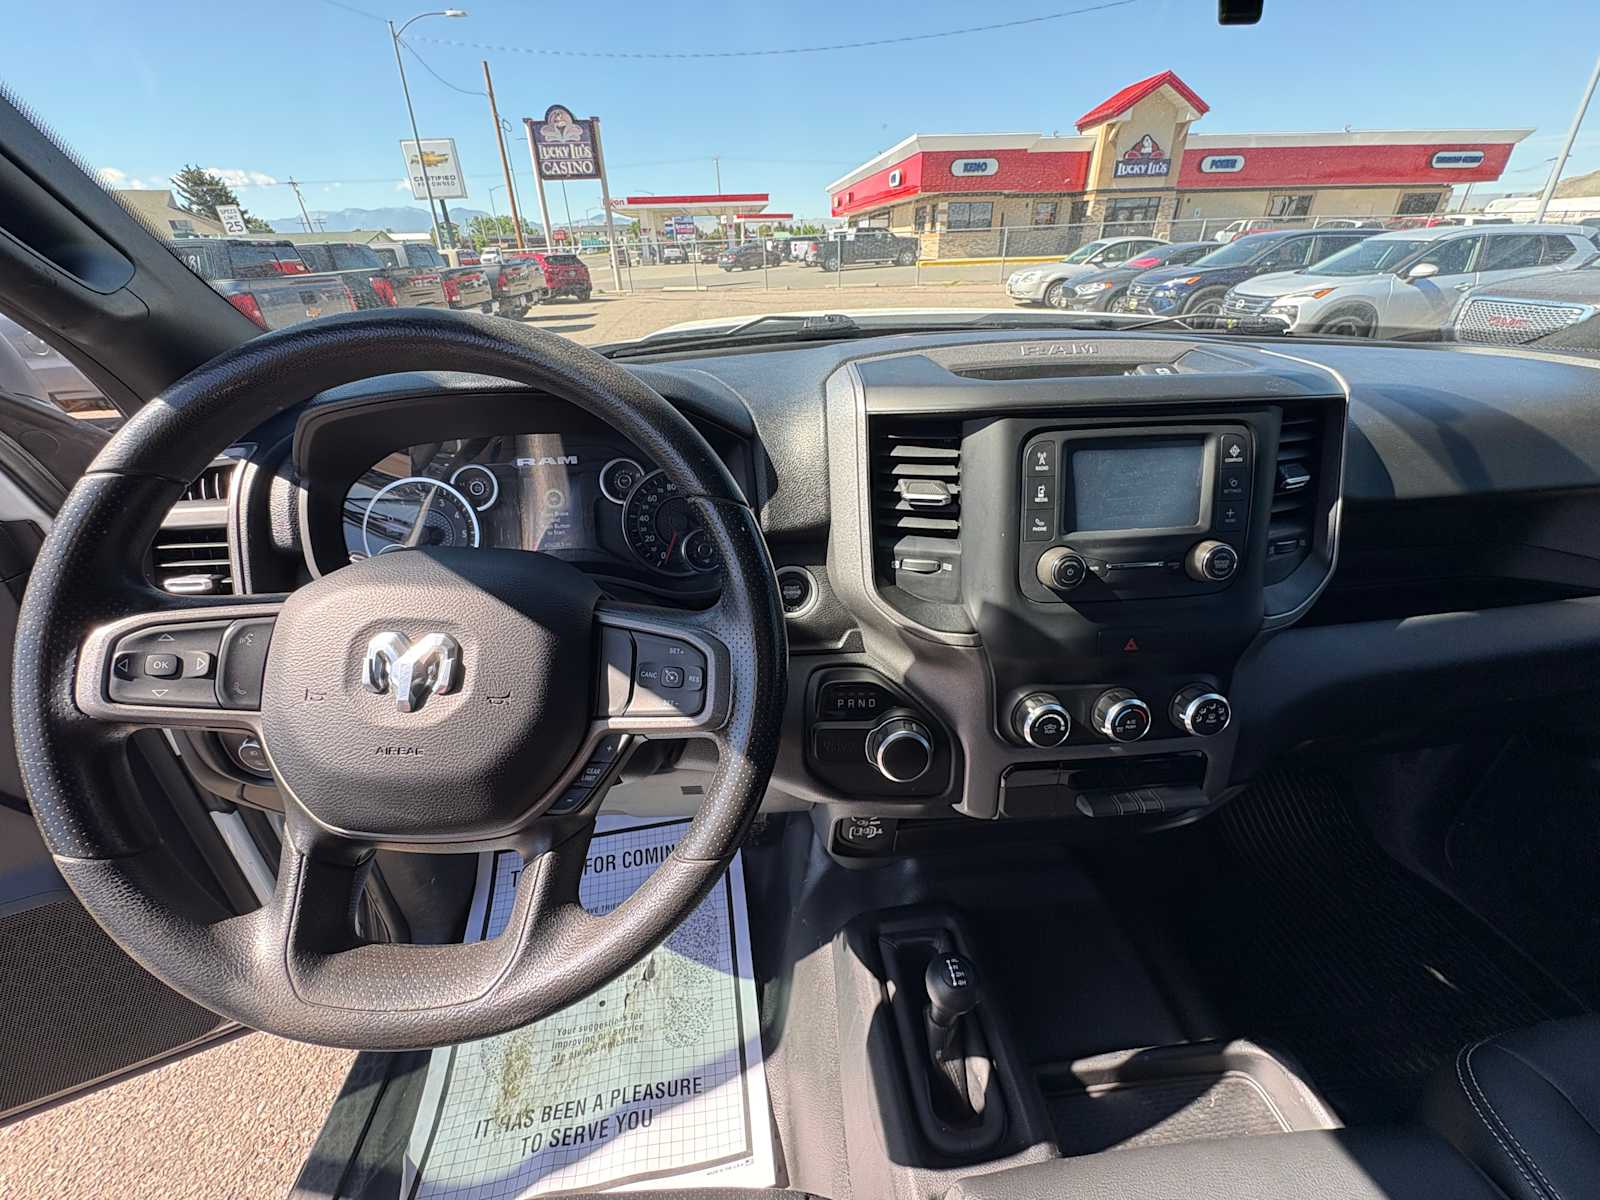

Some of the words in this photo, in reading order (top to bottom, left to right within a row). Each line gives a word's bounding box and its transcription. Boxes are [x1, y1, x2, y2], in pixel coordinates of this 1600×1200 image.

[539, 143, 570, 160] LUCKY
[542, 161, 594, 175] CASINO
[1116, 162, 1148, 176] LUCKY
[226, 221, 243, 232] 25
[1020, 343, 1098, 356] RAM
[515, 455, 578, 466] RAM
[666, 483, 677, 491] 80
[645, 535, 655, 543] 20
[153, 660, 169, 669] OK
[640, 671, 658, 679] CANC
[688, 675, 700, 683] RES
[584, 853, 616, 875] FOR
[622, 844, 675, 869] COMIN
[557, 1026, 577, 1037] Your
[474, 1117, 494, 1140] IT
[540, 1097, 587, 1123] BEEN
[592, 1093, 603, 1112] A
[610, 1076, 702, 1108] PLEASURE
[521, 1132, 542, 1157] TO
[549, 1118, 609, 1148] SERVE
[616, 1109, 654, 1134] YOU
